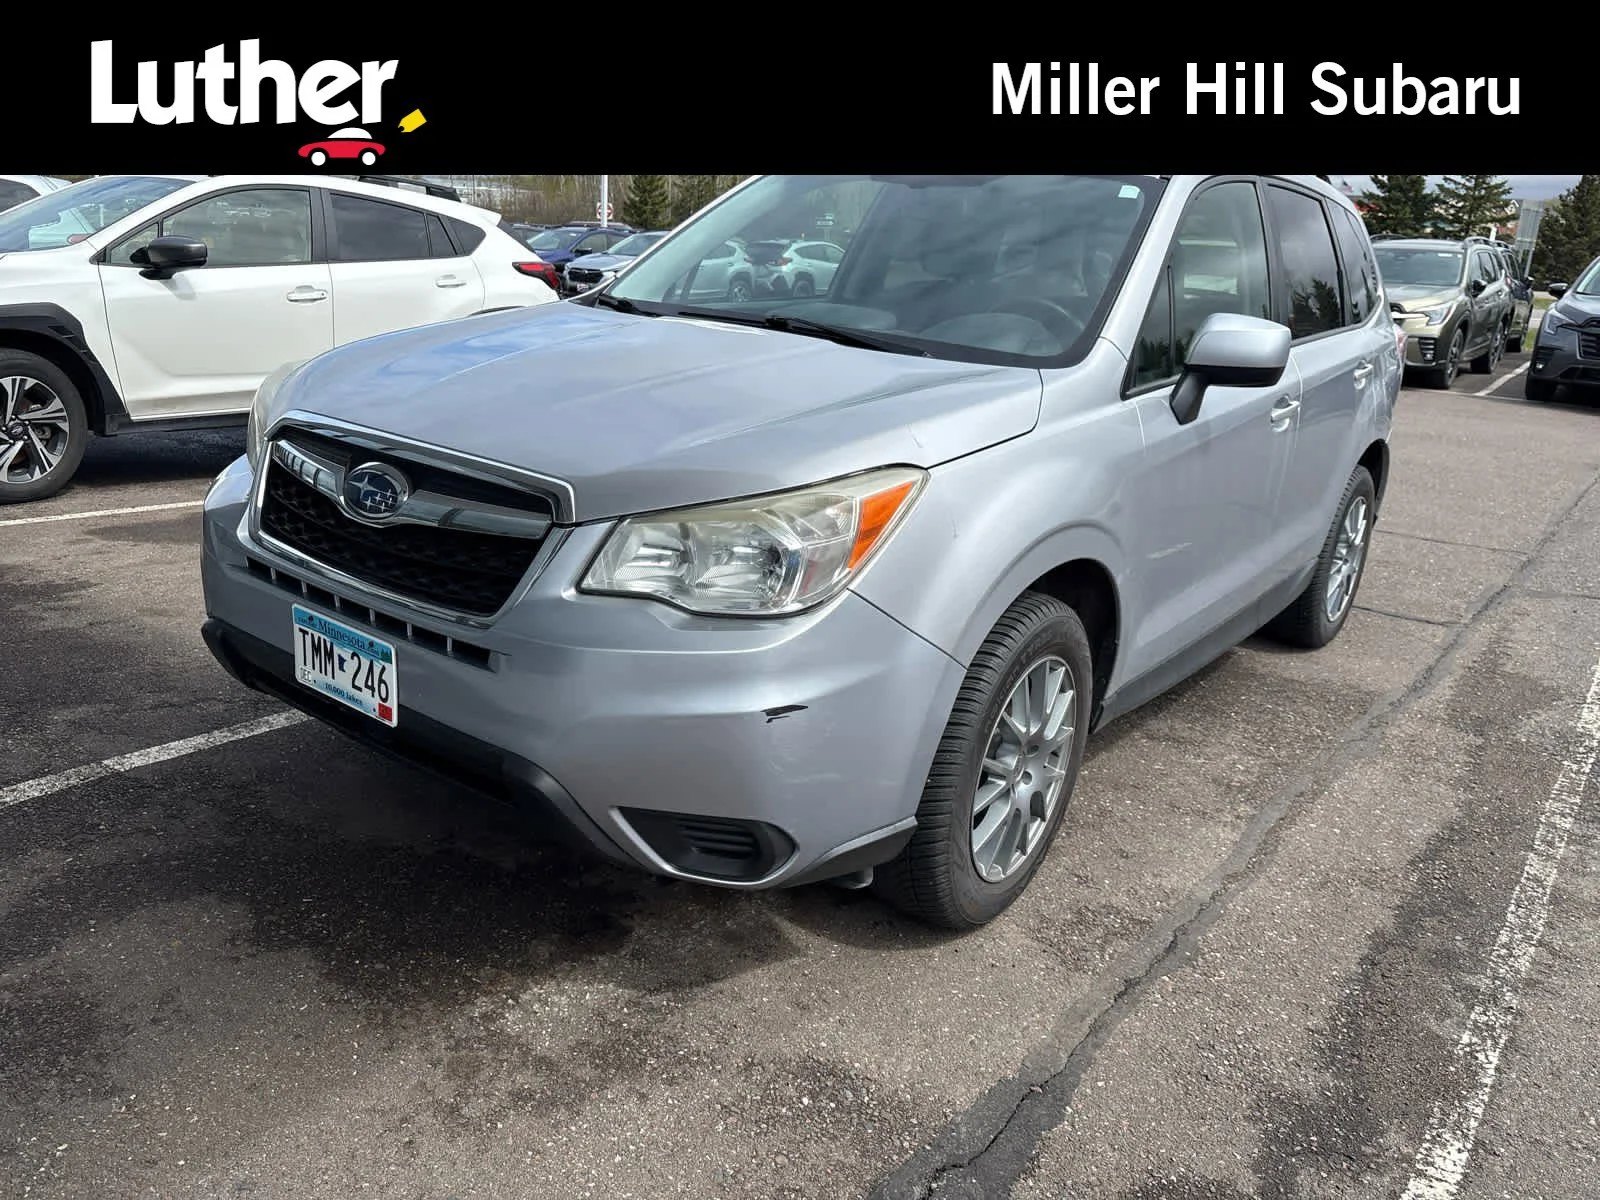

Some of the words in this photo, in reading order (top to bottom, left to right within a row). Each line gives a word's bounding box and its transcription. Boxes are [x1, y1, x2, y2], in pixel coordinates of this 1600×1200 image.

[317, 619, 365, 648] Minnesota
[298, 628, 335, 680] TMM
[350, 651, 389, 703] 246
